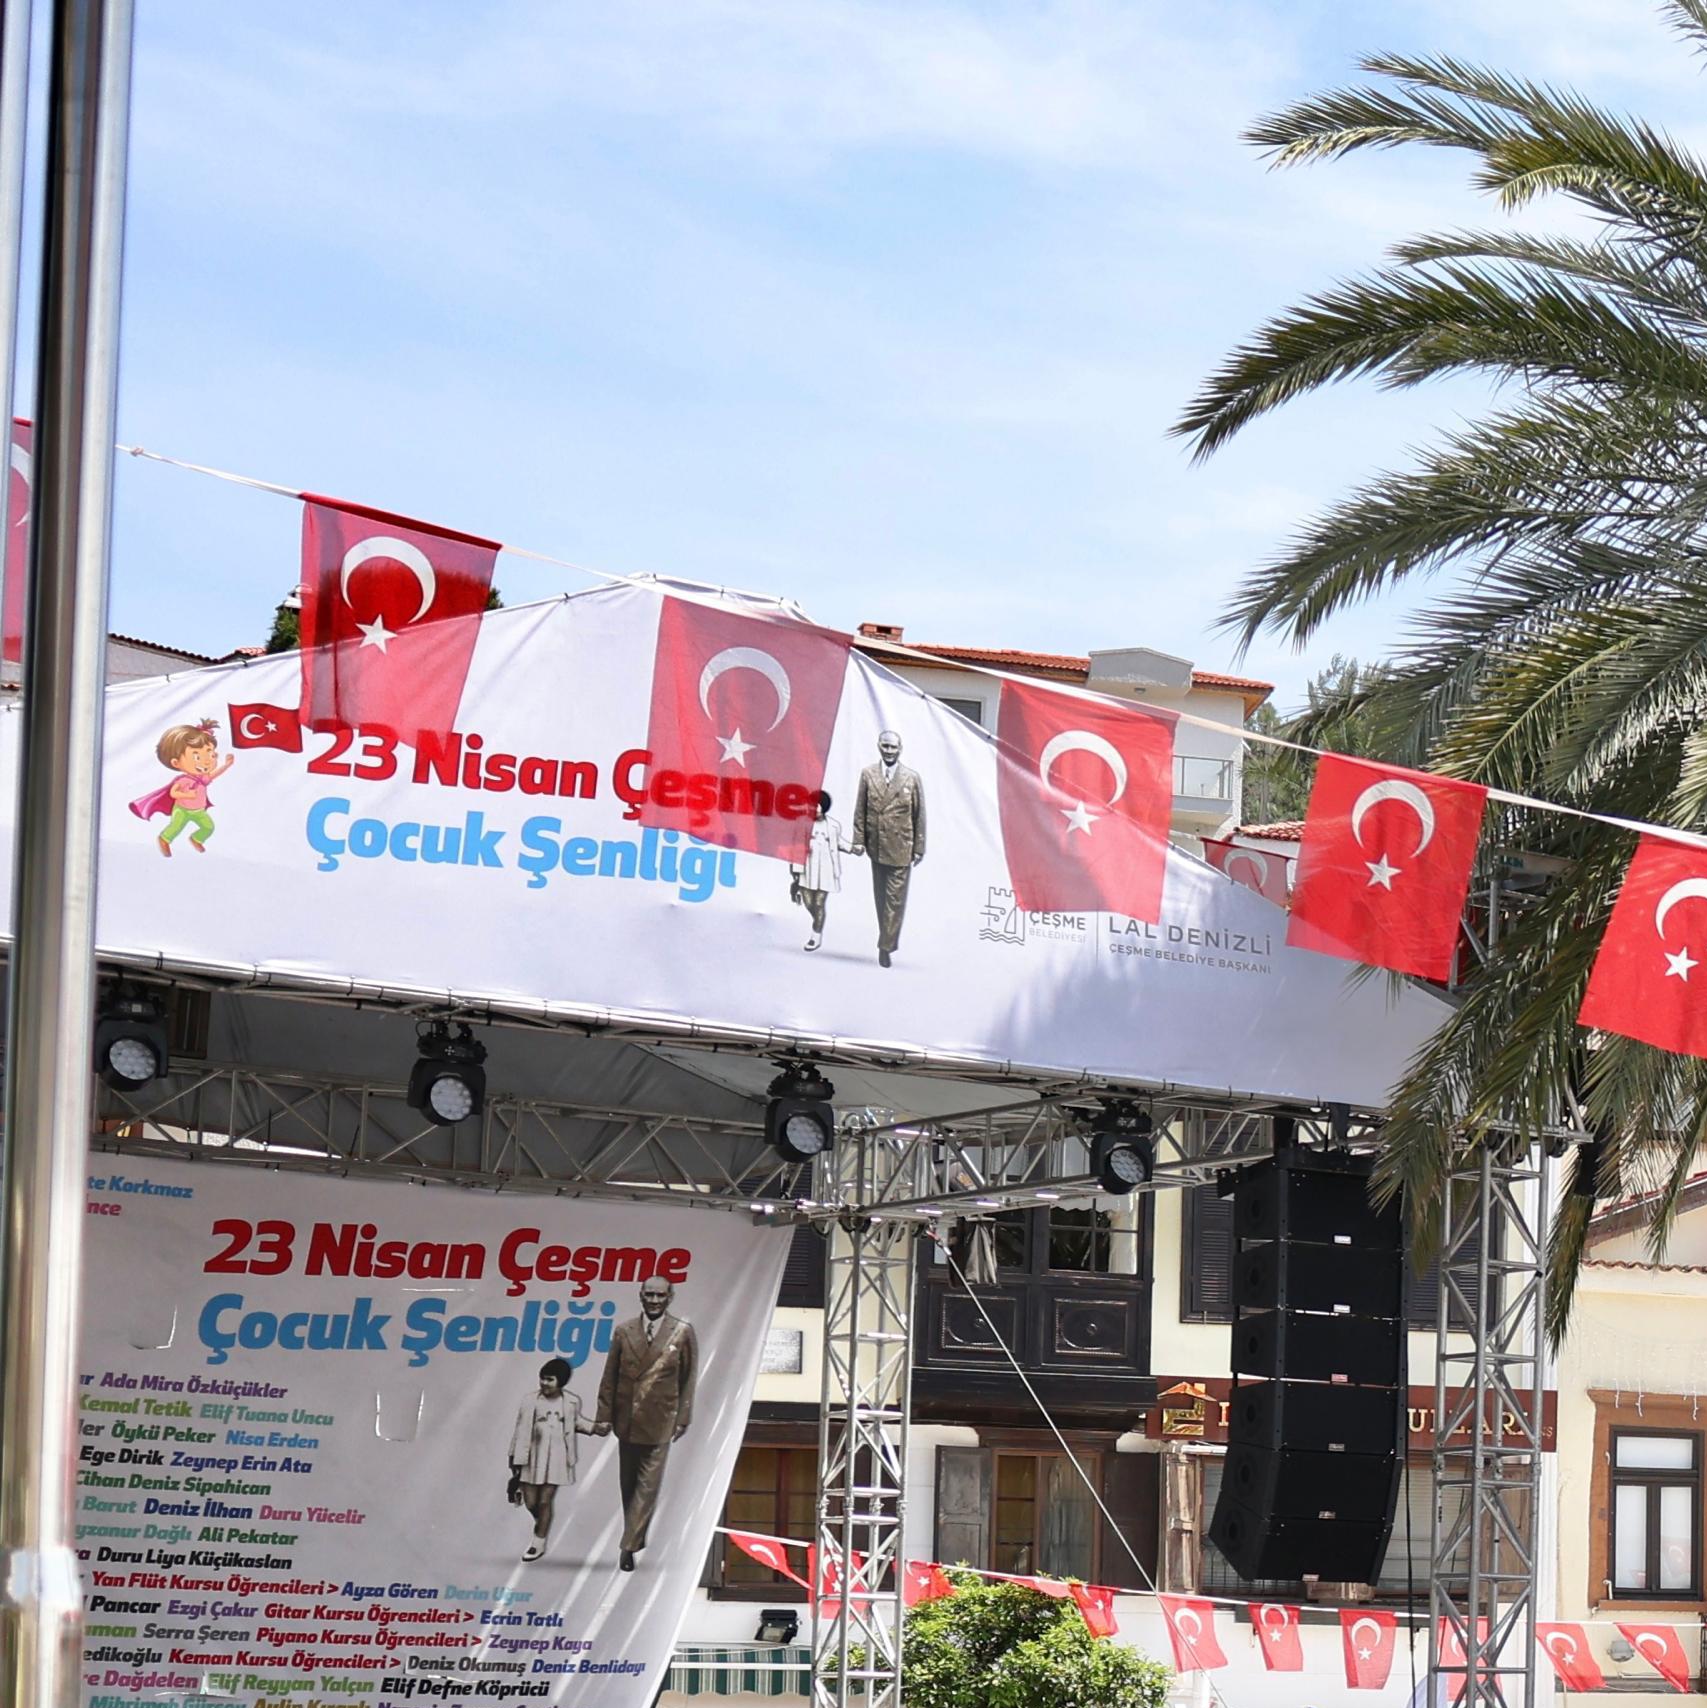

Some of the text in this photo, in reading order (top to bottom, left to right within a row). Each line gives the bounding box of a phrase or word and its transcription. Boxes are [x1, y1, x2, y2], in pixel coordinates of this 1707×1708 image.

[307, 719, 818, 828] 23 Nisan Çeşme
[306, 796, 737, 903] Çocuk Şenliği
[1167, 924, 1272, 956] DENİZLİ
[1109, 943, 1272, 975] ÇEŞME BELEDİYE BAŞKANI
[109, 1175, 194, 1199] Korkmaz
[203, 1218, 692, 1297] 23 Nisan Çeşme
[198, 1293, 616, 1370] Çocuk Şenliği
[100, 1372, 137, 1389] Ada
[141, 1375, 182, 1392] Mira
[187, 1375, 288, 1402] Özküçükler
[143, 1398, 192, 1417] Tetik
[200, 1401, 234, 1424] Elif
[236, 1403, 288, 1423] Tuana
[292, 1409, 333, 1425] Uncu
[111, 1420, 318, 1449] Öykü Peker Nisa Erden
[80, 1446, 312, 1473] Ege Dirik Zeynep Erin Ata
[128, 1474, 271, 1498] Deniz Sipahican
[83, 1496, 365, 1524] Barut Deniz İlhan Duru Yücelir
[143, 1524, 298, 1545] Dağlı Ali Pekatar
[97, 1547, 142, 1563] Duru
[146, 1547, 185, 1569] Liya
[189, 1551, 292, 1573] Küçükaslan
[92, 1571, 125, 1587] Yan
[128, 1571, 166, 1589] Flüt
[170, 1572, 223, 1591] Kursu
[227, 1574, 324, 1597] Öğrencileri
[342, 1582, 385, 1601] Ayza
[388, 1583, 438, 1599] Gören
[90, 1596, 161, 1613] Pancar
[167, 1600, 207, 1620] Ezgi
[210, 1599, 257, 1620] Çakır
[264, 1603, 309, 1619] Gitar
[313, 1602, 364, 1620] Kursu
[368, 1604, 459, 1627] Öğrencileri
[480, 1608, 522, 1627] Ecrin
[526, 1612, 563, 1627] Tatlı
[143, 1621, 592, 1656] Serra Şeren Piyano Kursu Öğrencileri Zeynep Kaya
[169, 1646, 645, 1677] Keman Kursu Öğrencileri Deniz Okumuş Deniz Benlidayı
[103, 1669, 198, 1694] Dağdelen
[208, 1672, 241, 1695] Elif
[242, 1673, 315, 1696] Reyyan
[320, 1676, 374, 1697] Yalçın
[380, 1676, 415, 1698] Elif
[418, 1677, 471, 1699] Defne
[475, 1678, 549, 1700] Köprücü
